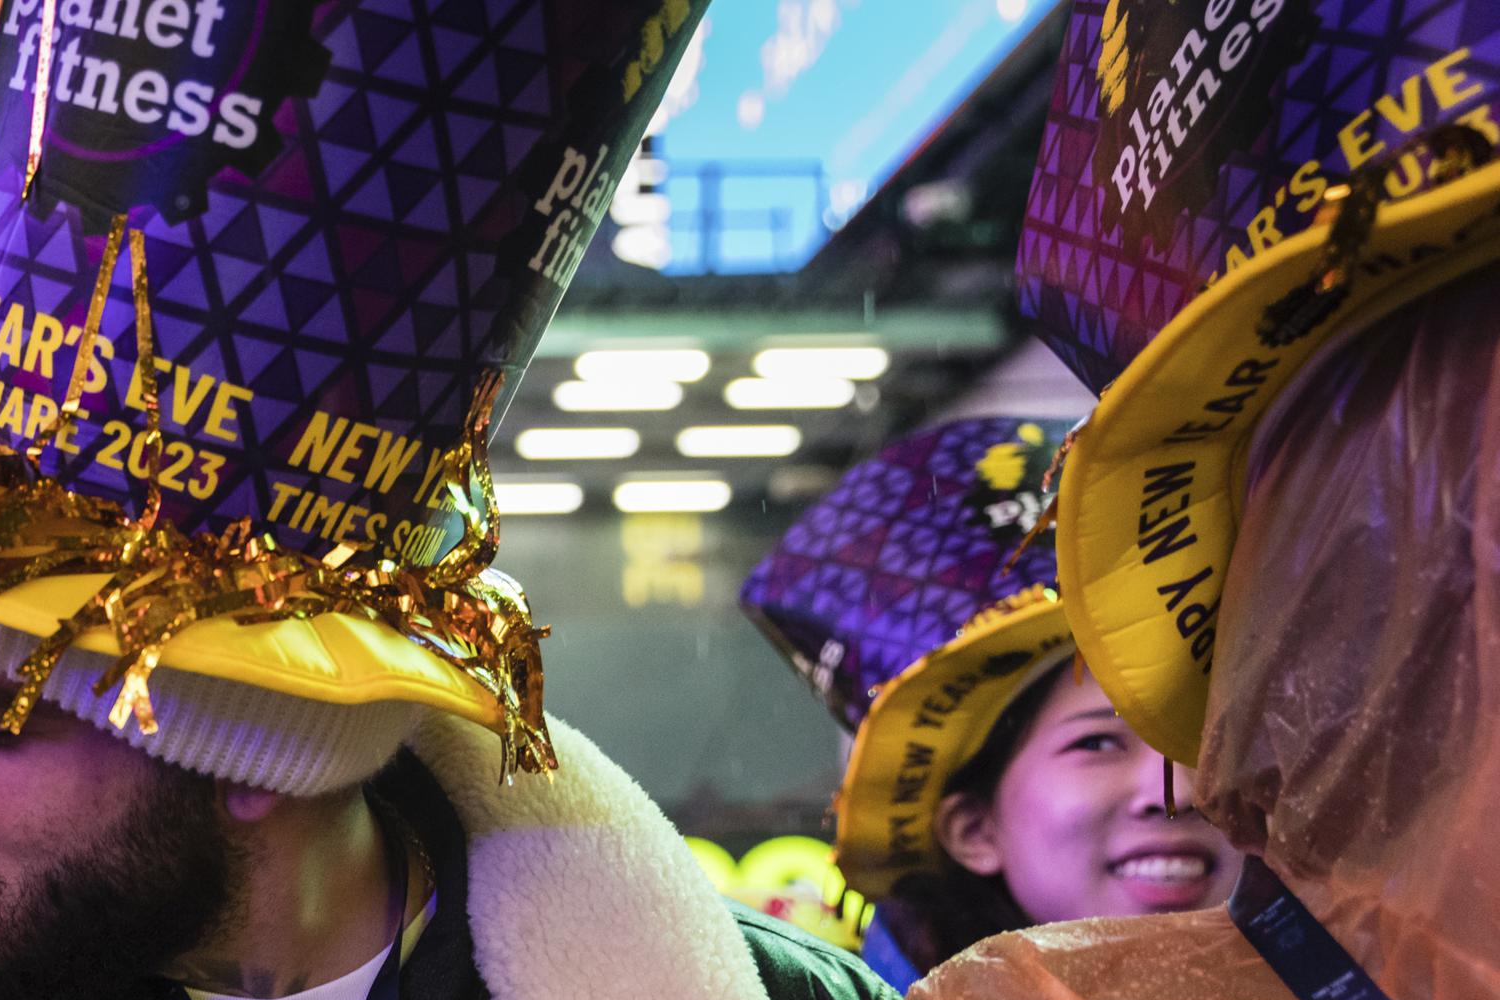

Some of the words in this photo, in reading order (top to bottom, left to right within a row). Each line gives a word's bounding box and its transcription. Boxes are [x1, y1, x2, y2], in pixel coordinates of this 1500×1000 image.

[3, 0, 225, 58] panet
[1206, 159, 1328, 289] AR'S
[1337, 47, 1484, 171] EVE
[95, 420, 227, 500] 2023
[287, 410, 423, 494] NEW
[266, 481, 389, 552] TIMES
[1136, 460, 1199, 565] NEW
